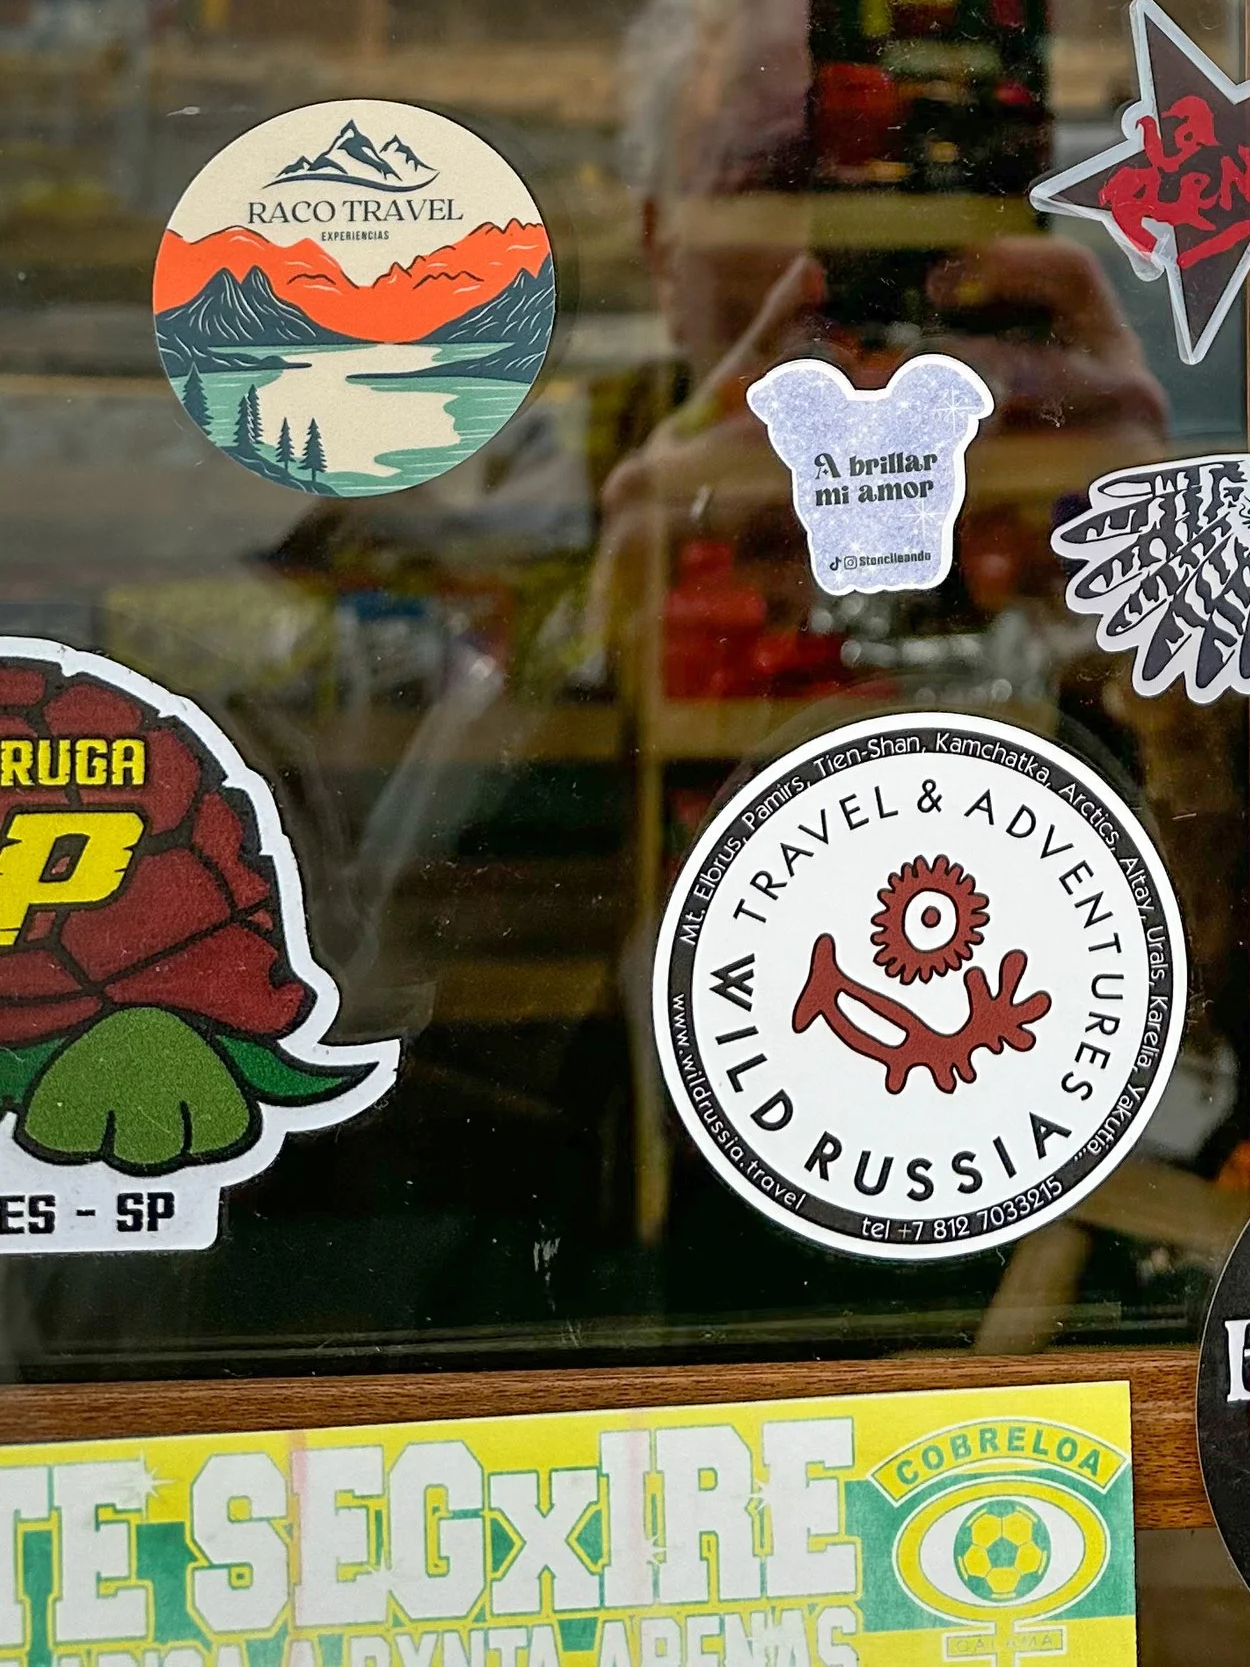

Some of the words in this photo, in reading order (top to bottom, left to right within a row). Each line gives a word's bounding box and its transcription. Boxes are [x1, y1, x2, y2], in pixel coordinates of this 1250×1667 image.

[248, 199, 336, 225] RACO
[342, 198, 464, 224] TRAVEL
[320, 229, 390, 242] EXPERIENCIAS
[813, 452, 842, 480] A
[849, 451, 938, 478] brillar
[815, 484, 850, 507] mi
[857, 479, 935, 503] amor
[813, 735, 928, 778] Tien-Shan,
[935, 732, 1051, 790] Kamchatka,
[742, 775, 812, 830] Pamirs,
[1058, 782, 1120, 853] Arctics,
[693, 835, 748, 900] Elbrus,
[1119, 857, 1155, 920] Altay,
[680, 908, 707, 946] Mt.
[733, 785, 899, 924] TRAVEL
[917, 778, 944, 815] &
[964, 787, 1126, 1102] ADVENTURES
[1146, 925, 1166, 986] Urals,
[1131, 995, 1169, 1073] Karelia,
[671, 994, 807, 1212] www.wildrussia.travel
[708, 952, 794, 1134] WILD
[804, 1109, 1074, 1202] RUSSIA
[116, 1191, 176, 1233] SP
[861, 1216, 891, 1239] tel
[896, 1220, 924, 1241] +7
[933, 1215, 970, 1240] 812
[976, 1177, 1065, 1232] 7033215
[896, 1426, 1102, 1488] COBRELOA
